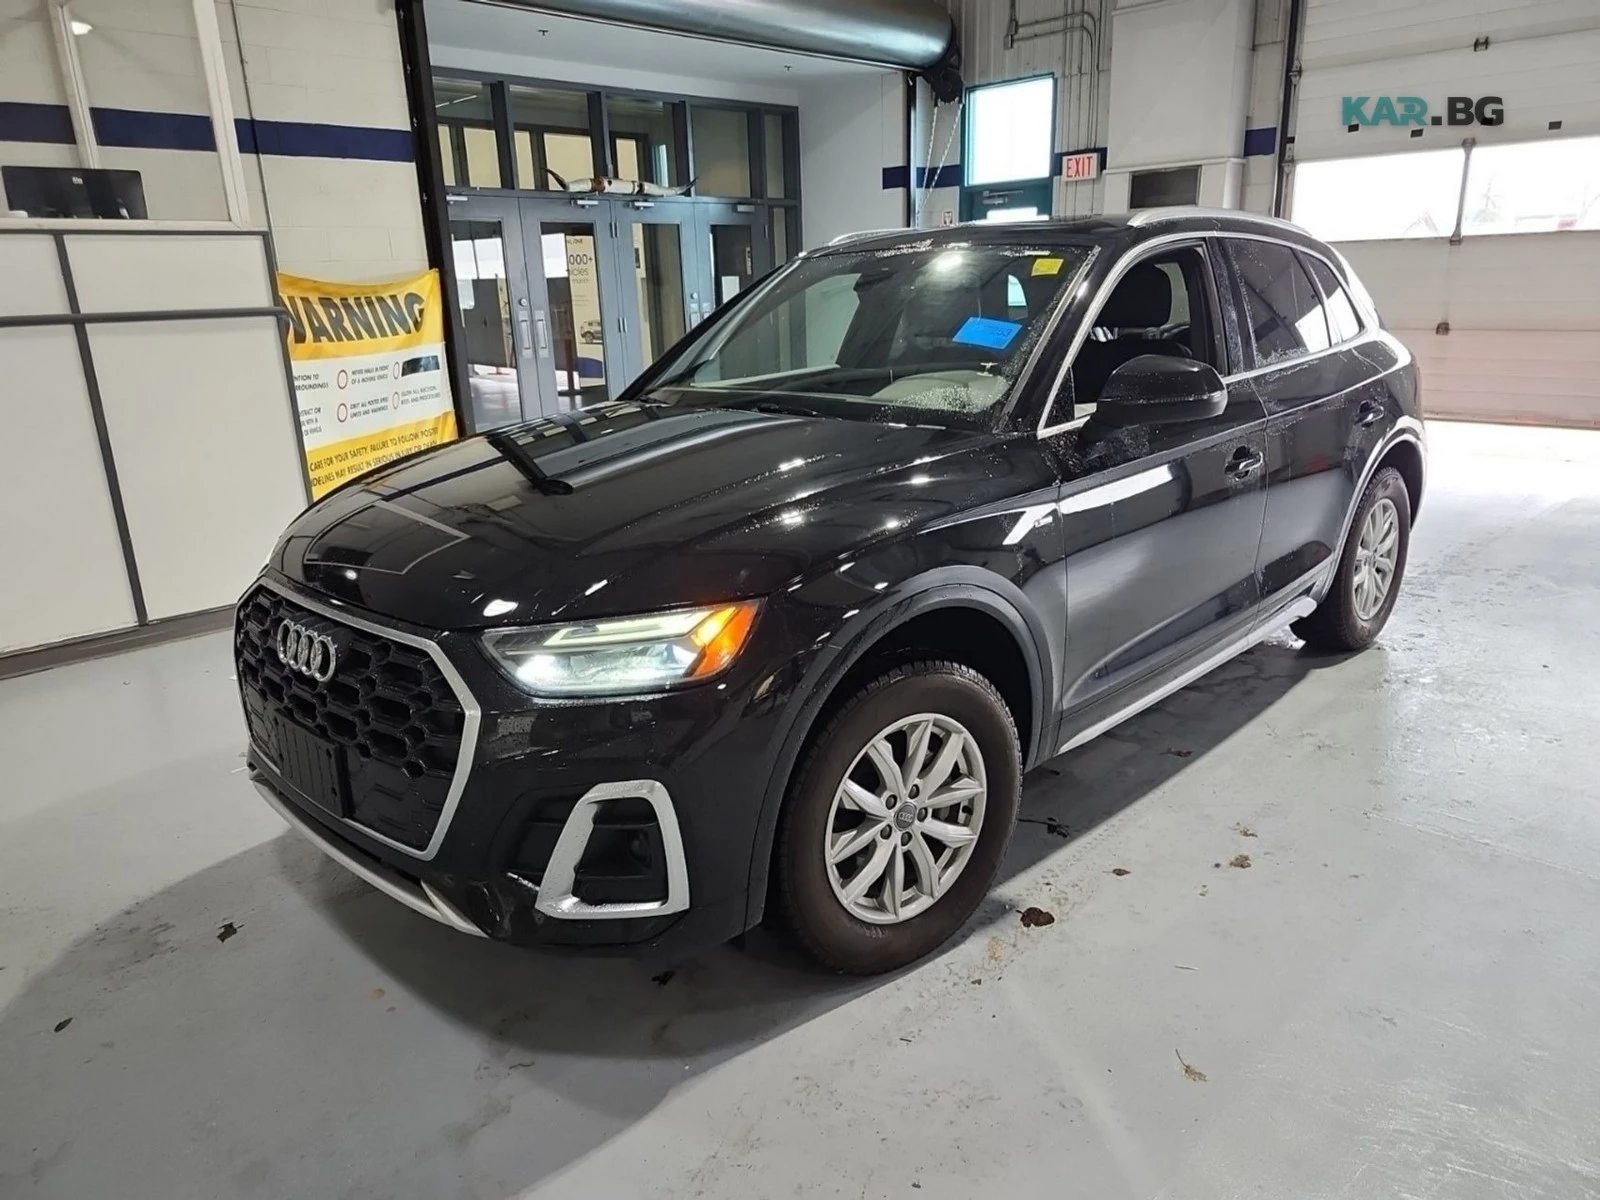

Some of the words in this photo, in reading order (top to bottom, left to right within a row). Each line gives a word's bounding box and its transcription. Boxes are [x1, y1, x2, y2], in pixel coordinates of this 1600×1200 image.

[1066, 156, 1093, 178] EXIT
[310, 459, 324, 472] CARE
[324, 456, 334, 467] FOR
[334, 452, 349, 463] YOUR
[370, 440, 389, 452] FAILURE
[390, 438, 397, 446] TO
[397, 432, 419, 445] FOLLOW
[335, 468, 347, 479] MAY
[347, 462, 365, 475] RESULT
[365, 460, 373, 470] IN
